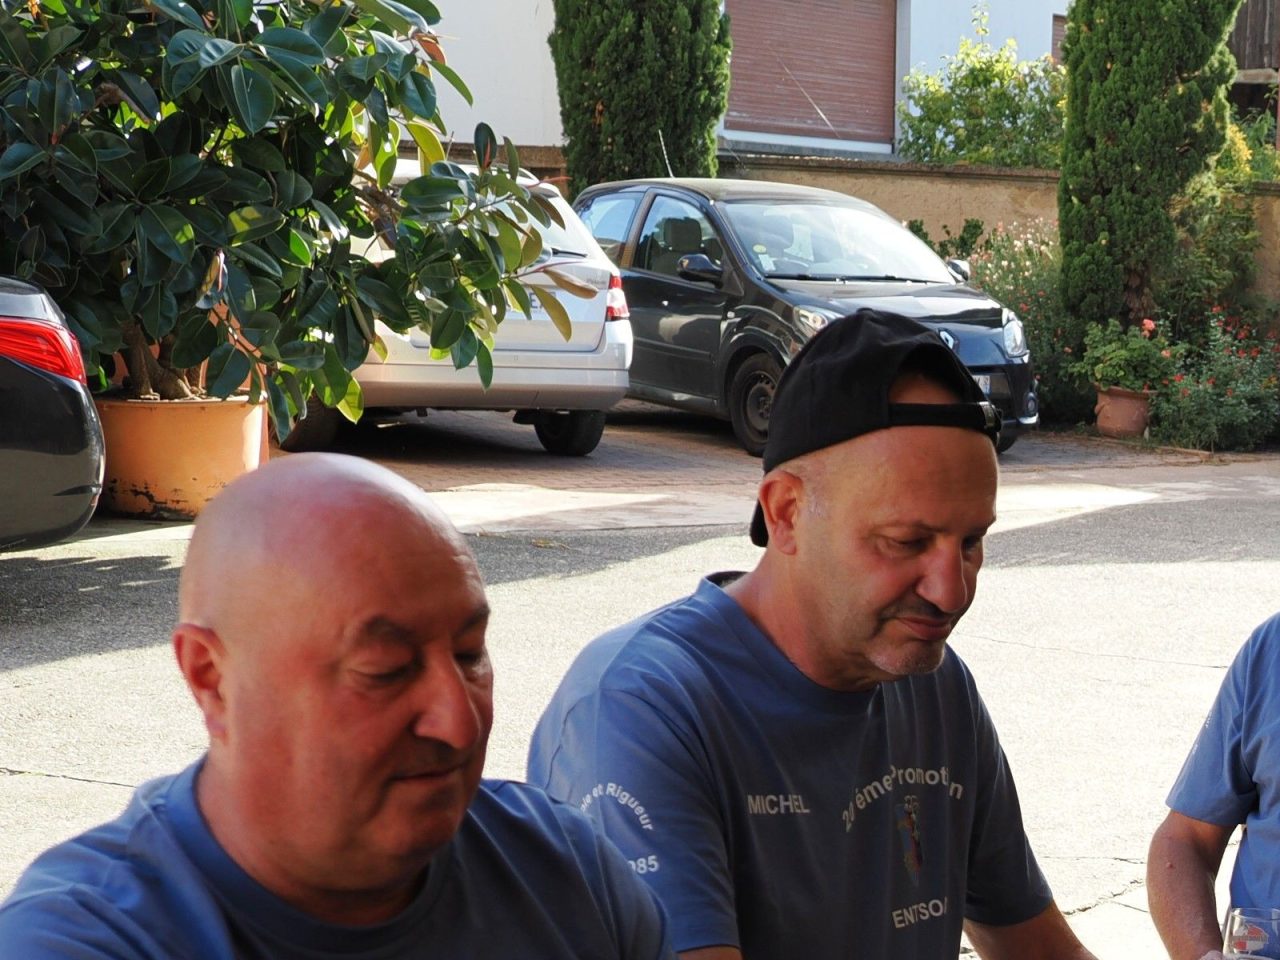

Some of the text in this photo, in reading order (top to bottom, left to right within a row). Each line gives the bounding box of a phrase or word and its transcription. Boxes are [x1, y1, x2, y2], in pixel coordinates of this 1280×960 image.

[592, 783, 604, 798] et
[605, 782, 654, 830] Rigueur
[747, 794, 810, 815] MICHEL
